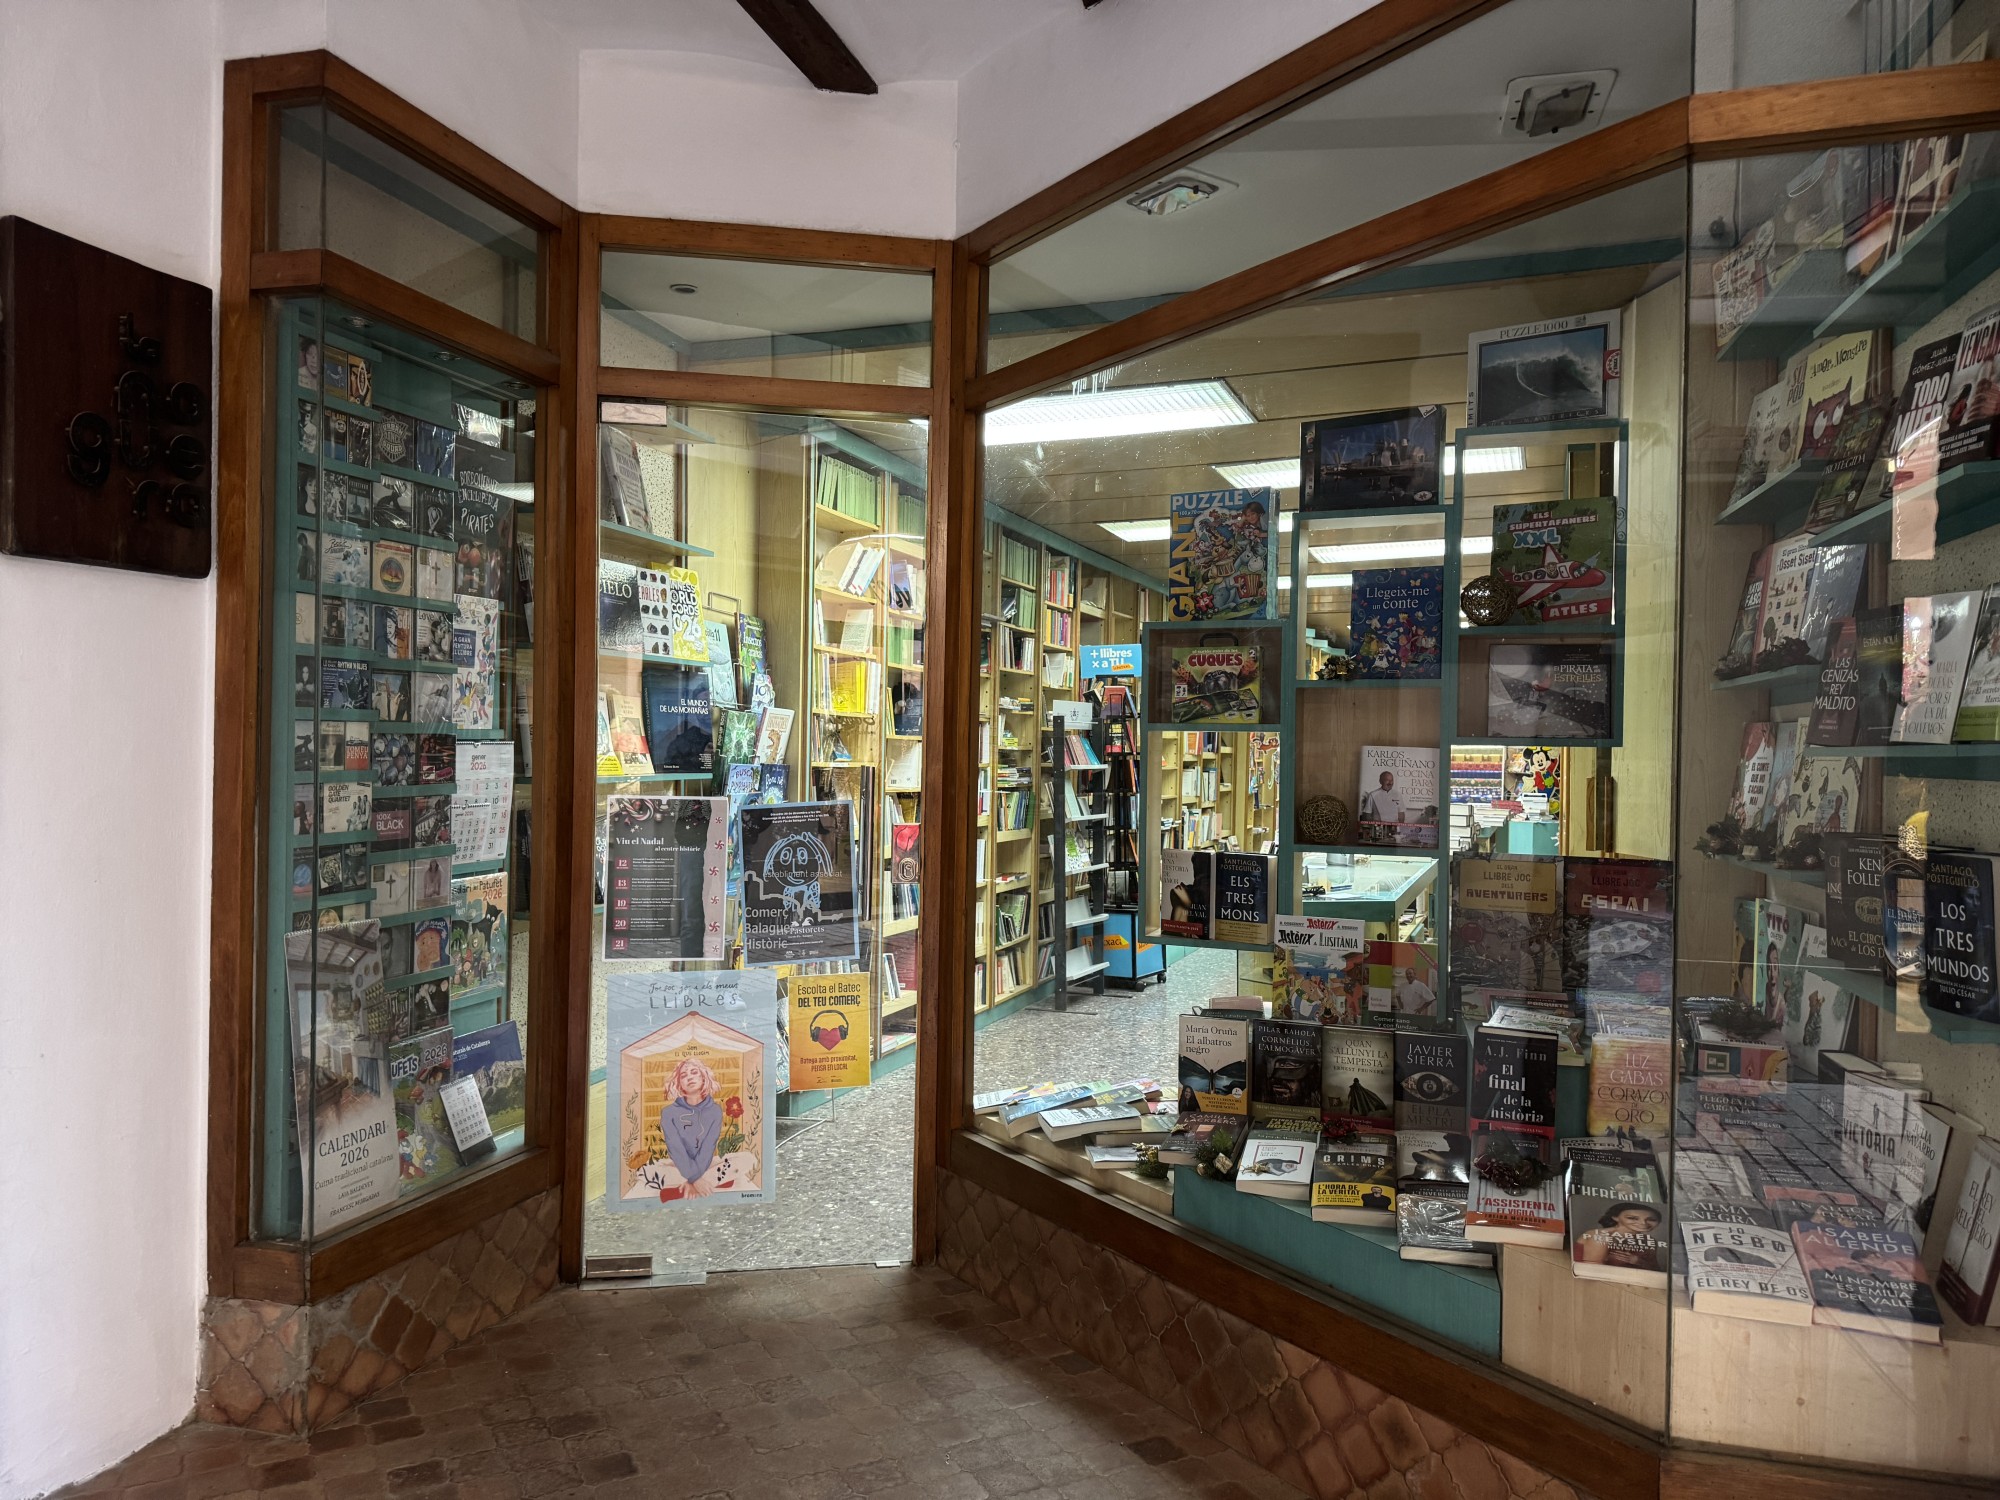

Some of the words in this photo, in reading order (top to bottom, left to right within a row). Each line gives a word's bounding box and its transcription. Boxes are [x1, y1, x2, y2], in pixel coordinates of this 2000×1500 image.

[1500, 325, 1542, 339] PUZZLE
[1543, 320, 1568, 333] 1000
[1911, 371, 1950, 411] TODO
[1172, 490, 1244, 511] PUZZLE
[461, 507, 494, 534] PIRATES
[1508, 514, 1597, 531] SUPERTAFANERS
[1532, 512, 1550, 521] ELS
[1513, 527, 1561, 548] XXL
[1798, 549, 1816, 567] Siset
[1169, 511, 1197, 622] GIANT
[1366, 586, 1431, 599] Llegeix-me
[1372, 602, 1381, 610] un
[1382, 597, 1419, 610] conte
[1549, 602, 1599, 617] ATLES
[1100, 648, 1133, 658] llibres
[1102, 660, 1109, 668] a
[1188, 652, 1244, 667] CUQUES
[1835, 658, 1850, 668] LAS
[1560, 664, 1593, 675] PIRATA
[1554, 673, 1601, 683] ESTRELLES
[1821, 669, 1859, 683] CENIZAS
[1829, 683, 1845, 695] REY
[687, 699, 708, 707] MUNDO
[1813, 696, 1856, 711] MALDITO
[660, 704, 667, 713] DE
[667, 705, 678, 714] LAS
[678, 705, 709, 716] MONTAÑAS
[1367, 749, 1405, 759] KARLOS
[470, 762, 487, 771] 2026
[1372, 757, 1436, 769] ARGUIÑANO
[1751, 762, 1757, 772] EL
[1397, 769, 1435, 779] COCINA
[1750, 774, 1759, 784] QUE
[1759, 774, 1766, 784] NO
[328, 784, 350, 792] GOLDEN
[1411, 779, 1434, 787] PARA
[1400, 787, 1434, 796] TODOS
[328, 795, 351, 804] QUARTET
[376, 819, 404, 831] BLACK
[616, 837, 631, 845] Viu
[631, 837, 639, 845] el
[641, 837, 664, 845] Nadal
[618, 859, 628, 867] 12
[1224, 858, 1258, 867] SANTIAGO
[1859, 857, 1881, 871] KEN
[764, 869, 809, 879] establiment
[810, 870, 843, 878] associat
[1220, 865, 1261, 873] POSTEGUILLO
[1931, 862, 1973, 877] SANTIAGO
[1230, 875, 1250, 888] ELS
[1483, 871, 1513, 882] LLIBRE
[1514, 872, 1531, 882] JOC
[1591, 877, 1621, 887] LLIBRE
[1623, 878, 1641, 887] JOC
[1926, 872, 1980, 889] POSTEGUILLO
[479, 879, 503, 892] Patufet
[618, 880, 627, 888] 13
[482, 888, 503, 901] 2026
[1225, 891, 1254, 905] TRES
[1466, 888, 1548, 902] AVENTURERS
[1581, 893, 1650, 912] ESPAI
[745, 907, 789, 919] Comerç
[1220, 907, 1260, 922] MONS
[1888, 908, 1896, 919] EL
[1940, 901, 1966, 922] LOS
[789, 925, 825, 935] Pastorets
[1848, 930, 1858, 942] EL
[615, 939, 624, 947] 21
[745, 937, 788, 949] Històric
[1278, 929, 1316, 946] Astèrix
[1319, 932, 1358, 949] LUSITÀNIA
[1935, 927, 1974, 953] TRES
[1858, 944, 1876, 957] LOS
[1926, 953, 1990, 983] MUNDOS
[715, 981, 739, 990] meus
[797, 984, 827, 995] Escolta
[828, 983, 836, 994] el
[838, 982, 861, 993] Batec
[1939, 983, 1957, 995] JULIO
[798, 997, 811, 1008] DEL
[813, 996, 828, 1007] TEU
[829, 994, 861, 1007] COMERÇ
[1373, 1015, 1395, 1023] Comer
[1186, 1024, 1209, 1034] María
[1210, 1025, 1238, 1036] Oruña
[1258, 1025, 1281, 1034] PILAR
[1284, 1027, 1316, 1037] RAHOLA
[1186, 1035, 1195, 1044] El
[1197, 1036, 1232, 1047] albatros
[1345, 1039, 1372, 1048] QUAN
[424, 1043, 448, 1062] 2026
[1185, 1045, 1211, 1055] negro
[1377, 1049, 1390, 1059] LA
[1409, 1043, 1453, 1058] JAVIER
[1516, 1048, 1547, 1062] Finn
[800, 1056, 818, 1065] Batega
[1335, 1055, 1384, 1068] TEMPESTA
[1407, 1053, 1455, 1068] SIERRA
[1625, 1053, 1650, 1069] LUZ
[811, 1065, 827, 1073] PENSA
[833, 1063, 848, 1071] LOCAL
[1333, 1065, 1355, 1073] ERNEST
[1502, 1064, 1514, 1075] El
[1488, 1074, 1526, 1092] final
[1503, 1095, 1519, 1106] de
[1521, 1095, 1532, 1107] la
[1412, 1104, 1422, 1114] EL
[1424, 1105, 1450, 1115] PLA
[1703, 1103, 1751, 1114] GARGANTA
[1189, 1113, 1236, 1121] CAMILLA
[1408, 1115, 1454, 1126] MESTRE
[1490, 1107, 1544, 1123] història
[1615, 1107, 1654, 1124] ORO
[319, 1120, 387, 1157] CALENDARI
[1842, 1117, 1896, 1160] VICTORIA
[340, 1144, 370, 1167] 2026
[1323, 1154, 1385, 1166] CRIMS
[334, 1164, 369, 1183] tradicional
[1968, 1180, 1980, 1200] EL
[1476, 1196, 1556, 1212] L'ASSISTENTA
[1695, 1202, 1750, 1216] ALMA
[1690, 1211, 1758, 1226] NEGRA
[1595, 1229, 1655, 1241] ISABEL
[1728, 1226, 1745, 1235] JO
[1817, 1226, 1897, 1244] ISABEL
[1582, 1233, 1668, 1248] PREYSLER
[1805, 1234, 1915, 1256] ALLENDE
[1697, 1278, 1709, 1288] EL
[1721, 1279, 1750, 1290] REY
[1758, 1282, 1779, 1293] DE
[1824, 1272, 1843, 1282] MI
[1847, 1275, 1919, 1292] NOMBRE
[1837, 1283, 1855, 1293] ES
[1860, 1286, 1912, 1300] EMILIA
[1838, 1291, 1863, 1302] DEL
[1869, 1296, 1914, 1308] VALLE
